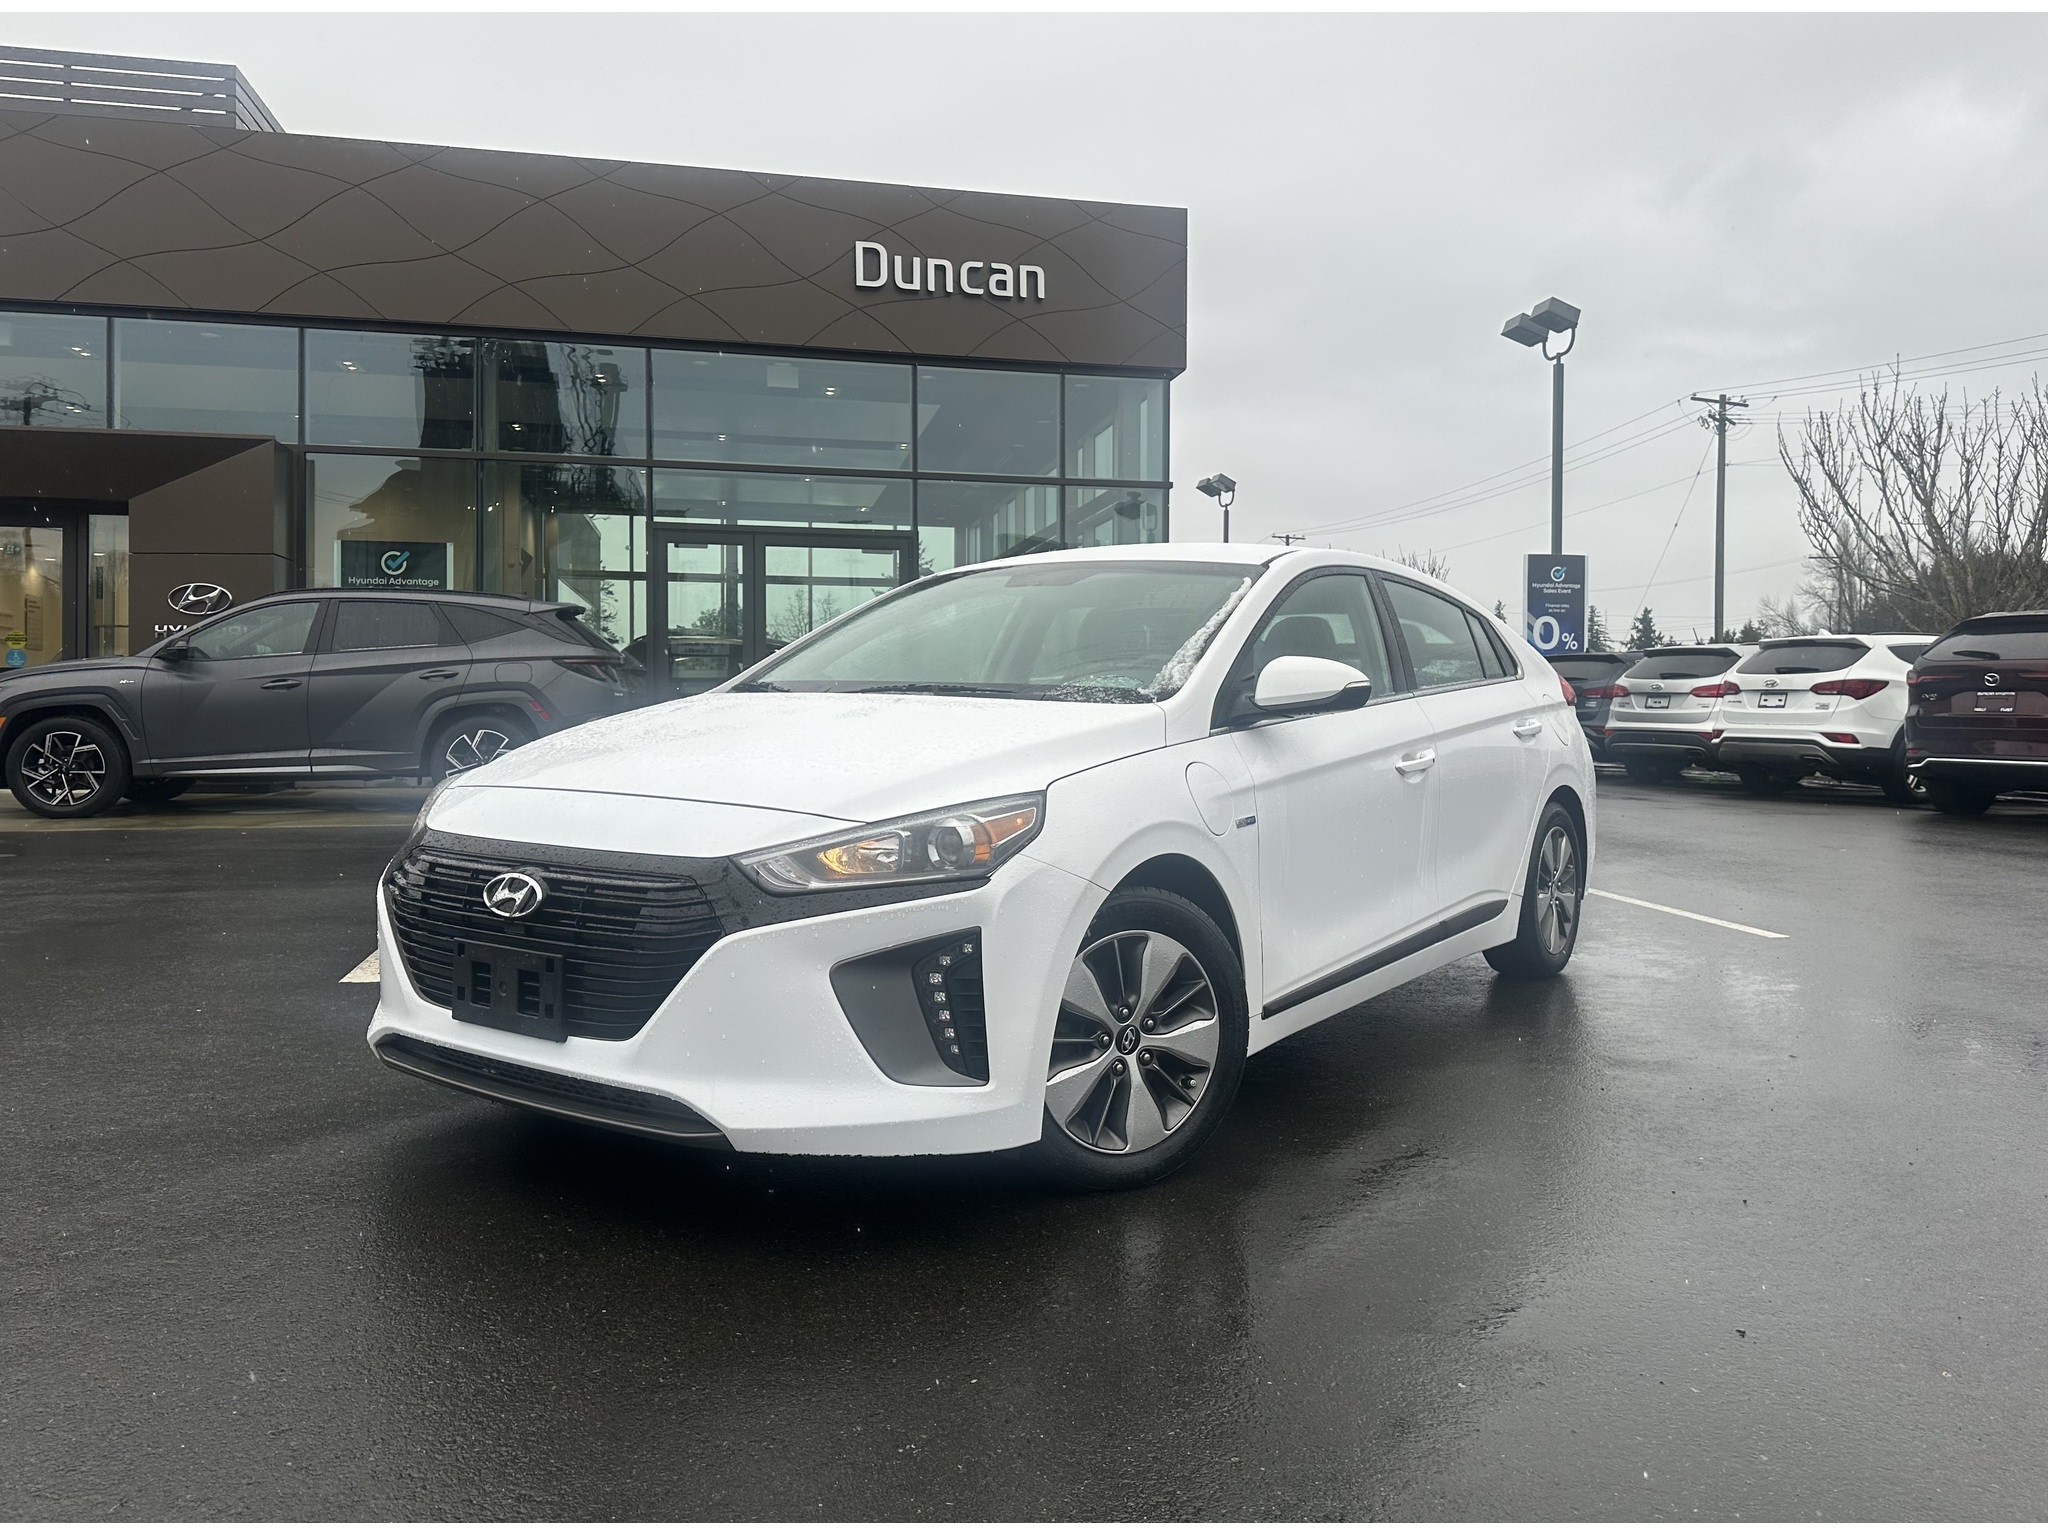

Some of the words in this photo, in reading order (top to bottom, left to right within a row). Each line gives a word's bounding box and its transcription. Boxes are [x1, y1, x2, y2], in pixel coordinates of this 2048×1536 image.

[855, 240, 1046, 299] Duncan
[348, 577, 387, 585] Hyundai
[388, 577, 440, 587] Advantage
